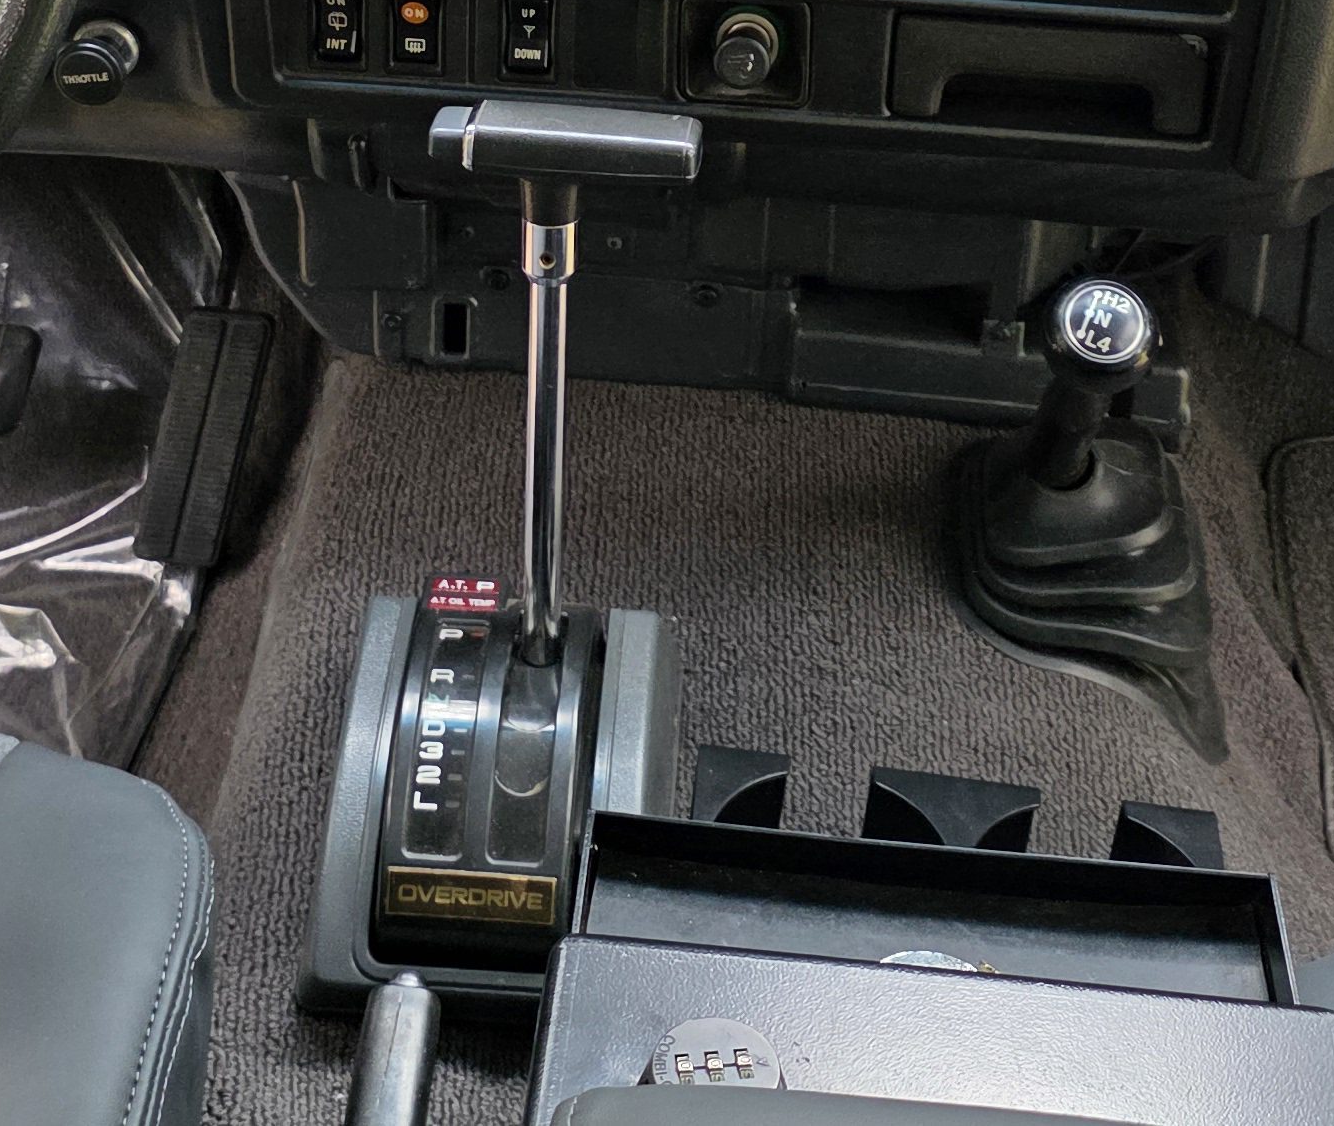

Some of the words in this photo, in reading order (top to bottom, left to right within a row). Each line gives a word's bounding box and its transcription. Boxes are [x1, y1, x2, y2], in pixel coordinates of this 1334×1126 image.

[403, 6, 425, 19] ON
[521, 7, 536, 19] UP
[325, 37, 348, 51] INT
[513, 47, 542, 61] DOWN
[62, 71, 110, 85] THROTTLE
[1101, 291, 1131, 314] H2
[1092, 309, 1113, 328] N
[1084, 329, 1113, 353] L4
[437, 578, 468, 591] A.T.
[475, 580, 495, 592] P
[447, 597, 466, 606] OIL
[468, 597, 496, 607] TEMP
[439, 628, 464, 641] P
[430, 668, 455, 684] R
[422, 720, 446, 737] D
[419, 741, 444, 759] 3
[415, 765, 442, 786] 2
[413, 791, 438, 811] L
[397, 883, 544, 911] OVERDRIVE
[654, 1034, 676, 1086] COMBI-
